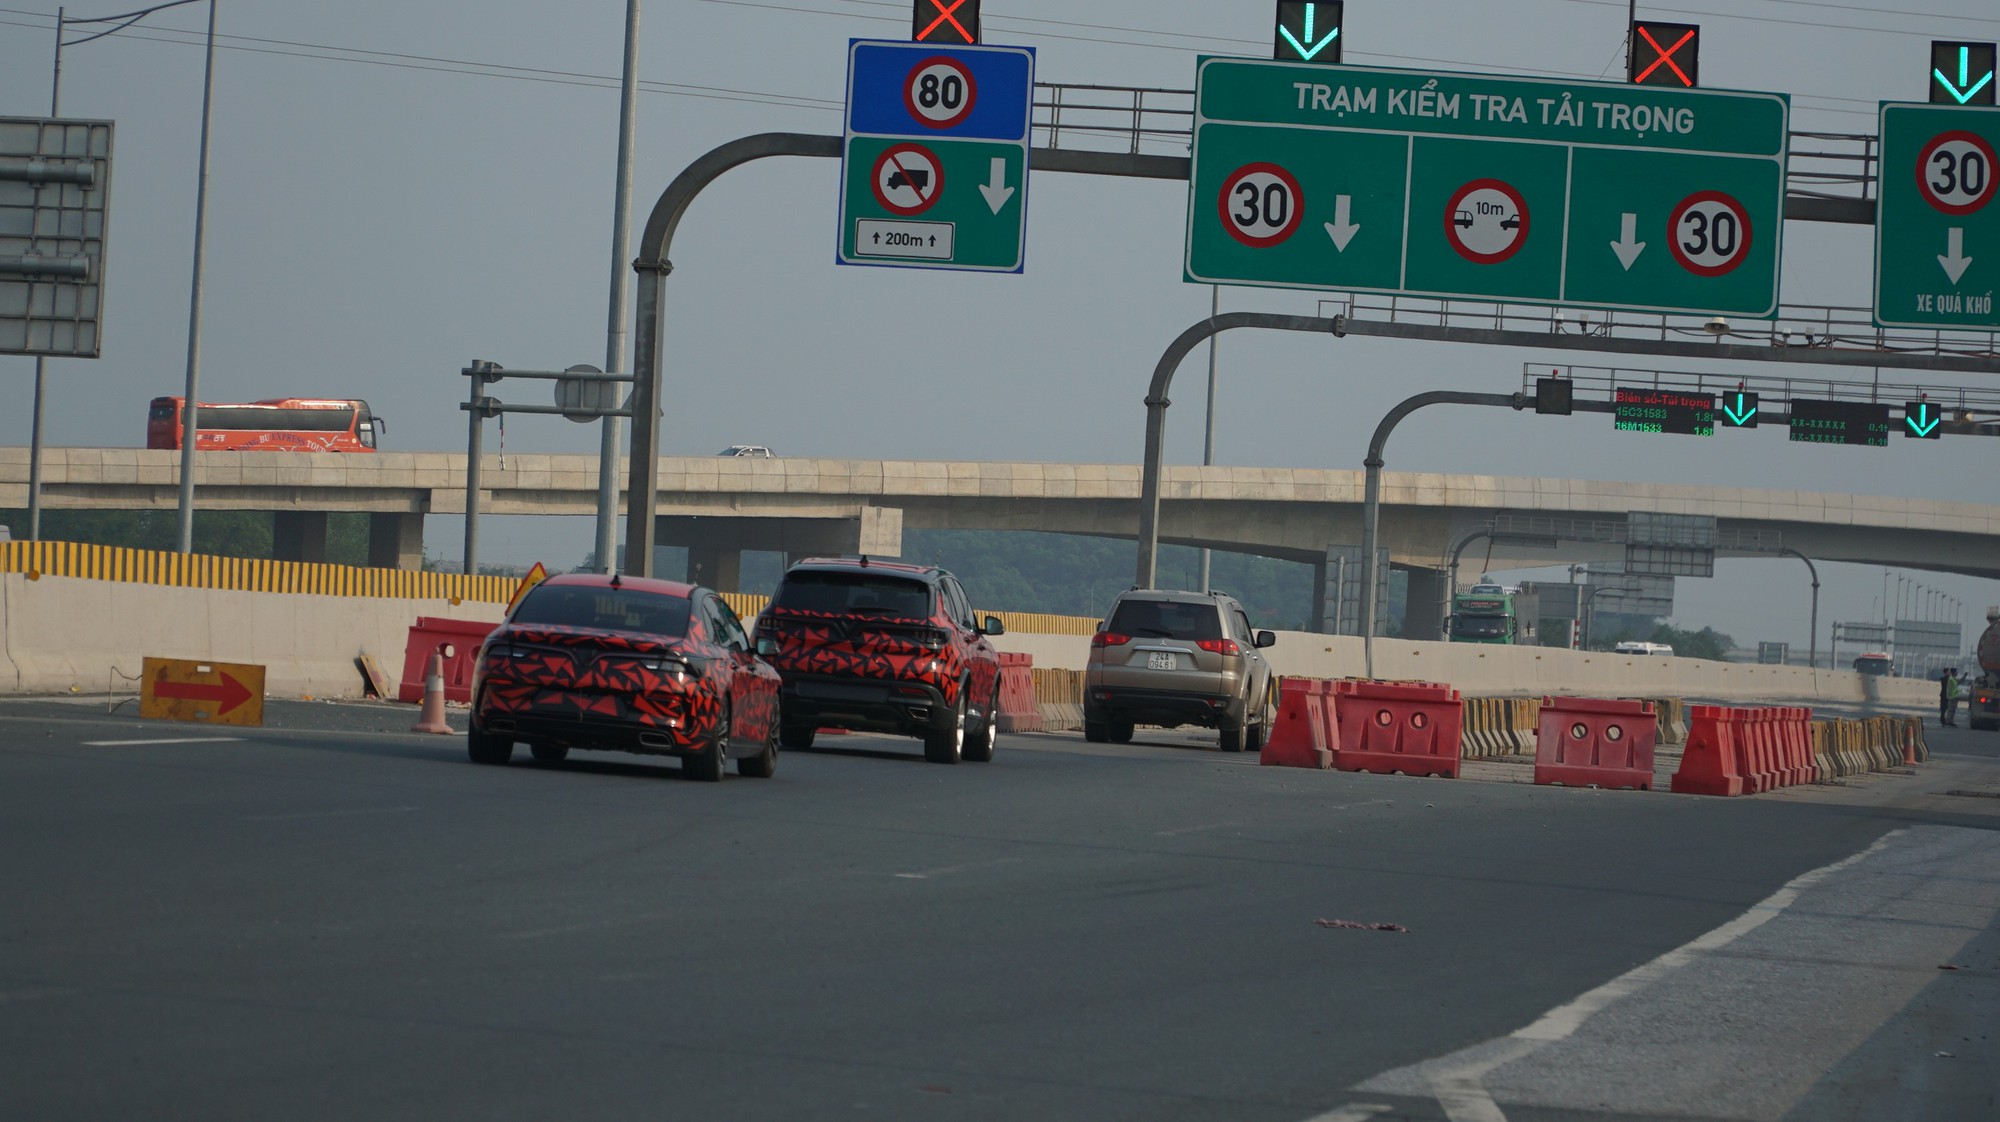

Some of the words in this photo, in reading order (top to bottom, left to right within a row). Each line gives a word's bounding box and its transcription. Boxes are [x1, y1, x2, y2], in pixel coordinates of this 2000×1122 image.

[918, 73, 963, 109] 80
[1293, 82, 1377, 118] TRẠM
[1387, 78, 1460, 120] KIỂM
[1469, 94, 1528, 124] TRA
[1536, 91, 1584, 127] TẢI
[1591, 102, 1696, 138] TRỌNG
[1931, 150, 1985, 196] 30
[1234, 181, 1288, 228] 30
[1475, 200, 1504, 216] 10m
[885, 232, 923, 247] 200m
[1683, 210, 1736, 257] 30
[1917, 293, 1933, 313] XE
[1937, 291, 1962, 315] QUÁ
[1966, 289, 1993, 315] KHỔ
[259, 433, 270, 443] BU
[271, 431, 305, 445] EXPRESS
[1155, 652, 1170, 661] 24A
